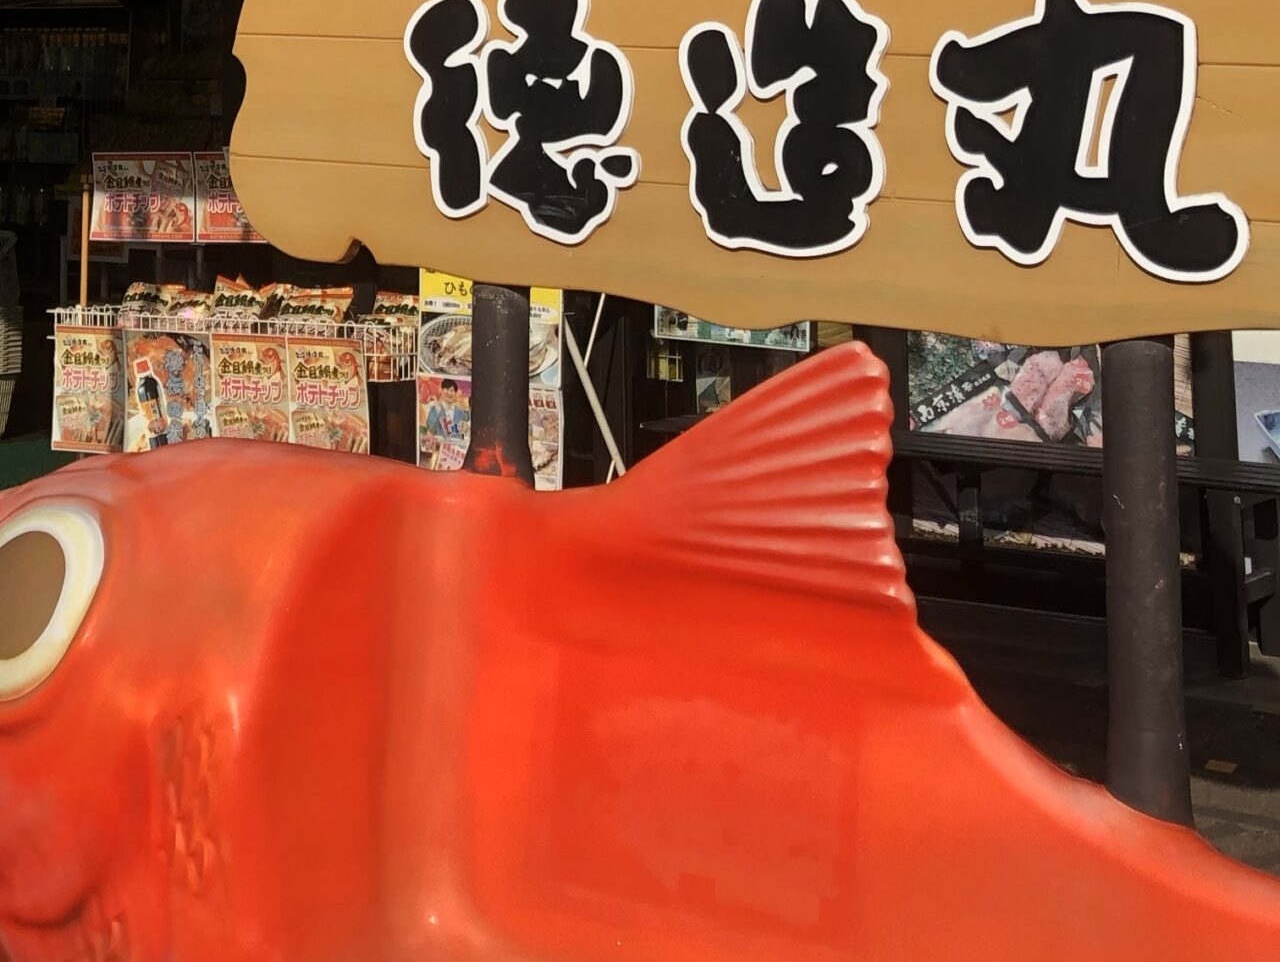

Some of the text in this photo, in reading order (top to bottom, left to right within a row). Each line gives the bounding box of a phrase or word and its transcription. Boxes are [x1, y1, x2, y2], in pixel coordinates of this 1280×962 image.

[206, 174, 235, 190] 金目
[104, 190, 161, 214] ポテトチップ
[444, 281, 473, 296] ひも
[62, 368, 120, 393] ポテトチップ
[220, 377, 284, 405] ポテトチップ
[295, 381, 362, 409] ポテトチップ
